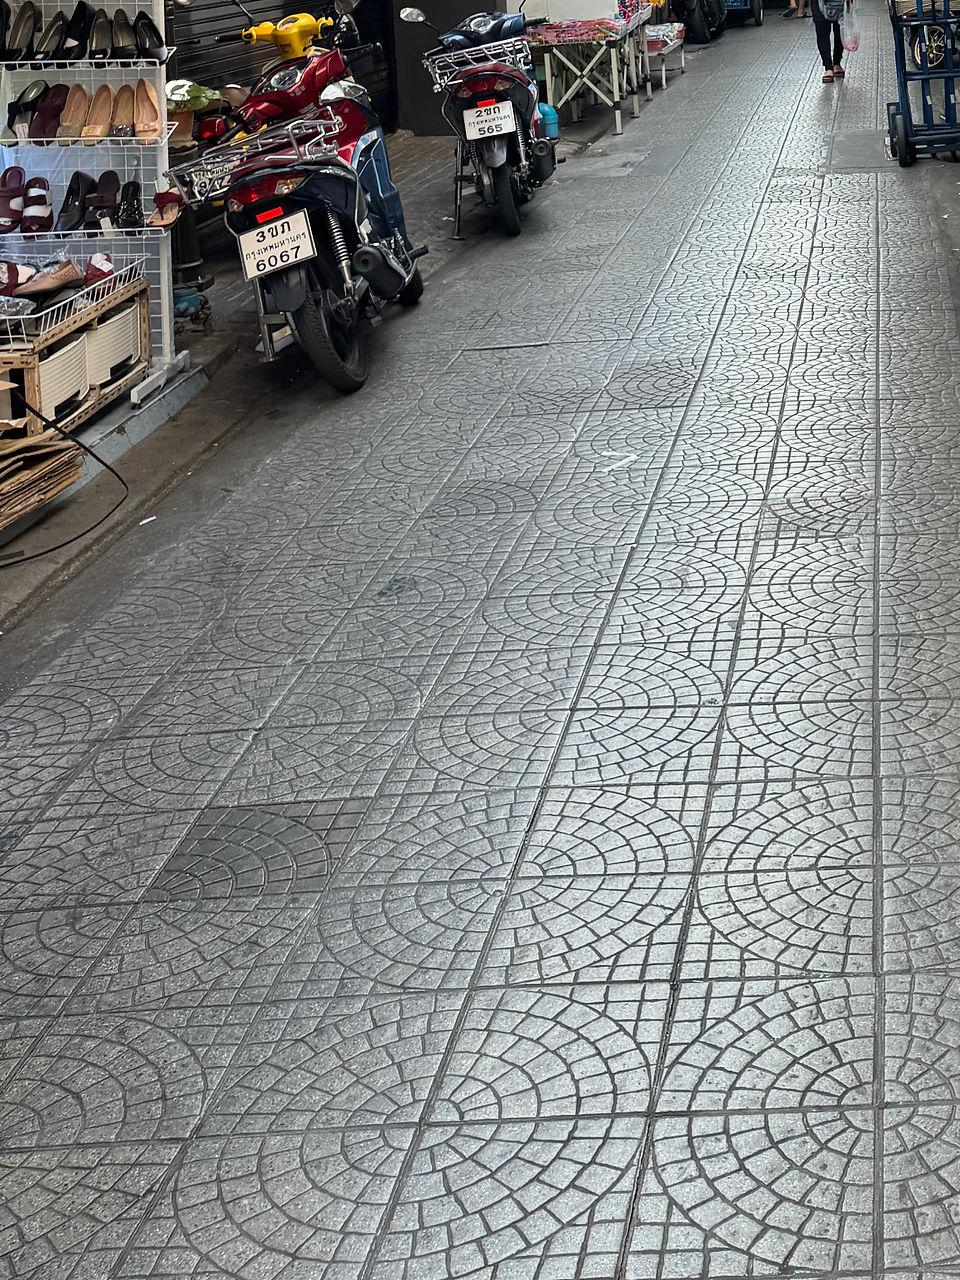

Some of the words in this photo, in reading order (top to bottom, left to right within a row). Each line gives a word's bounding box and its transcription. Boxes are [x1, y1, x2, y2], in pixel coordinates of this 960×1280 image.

[478, 123, 503, 136] 565
[245, 232, 307, 261] กรุงเทพมหานคร
[256, 245, 301, 272] 6067
